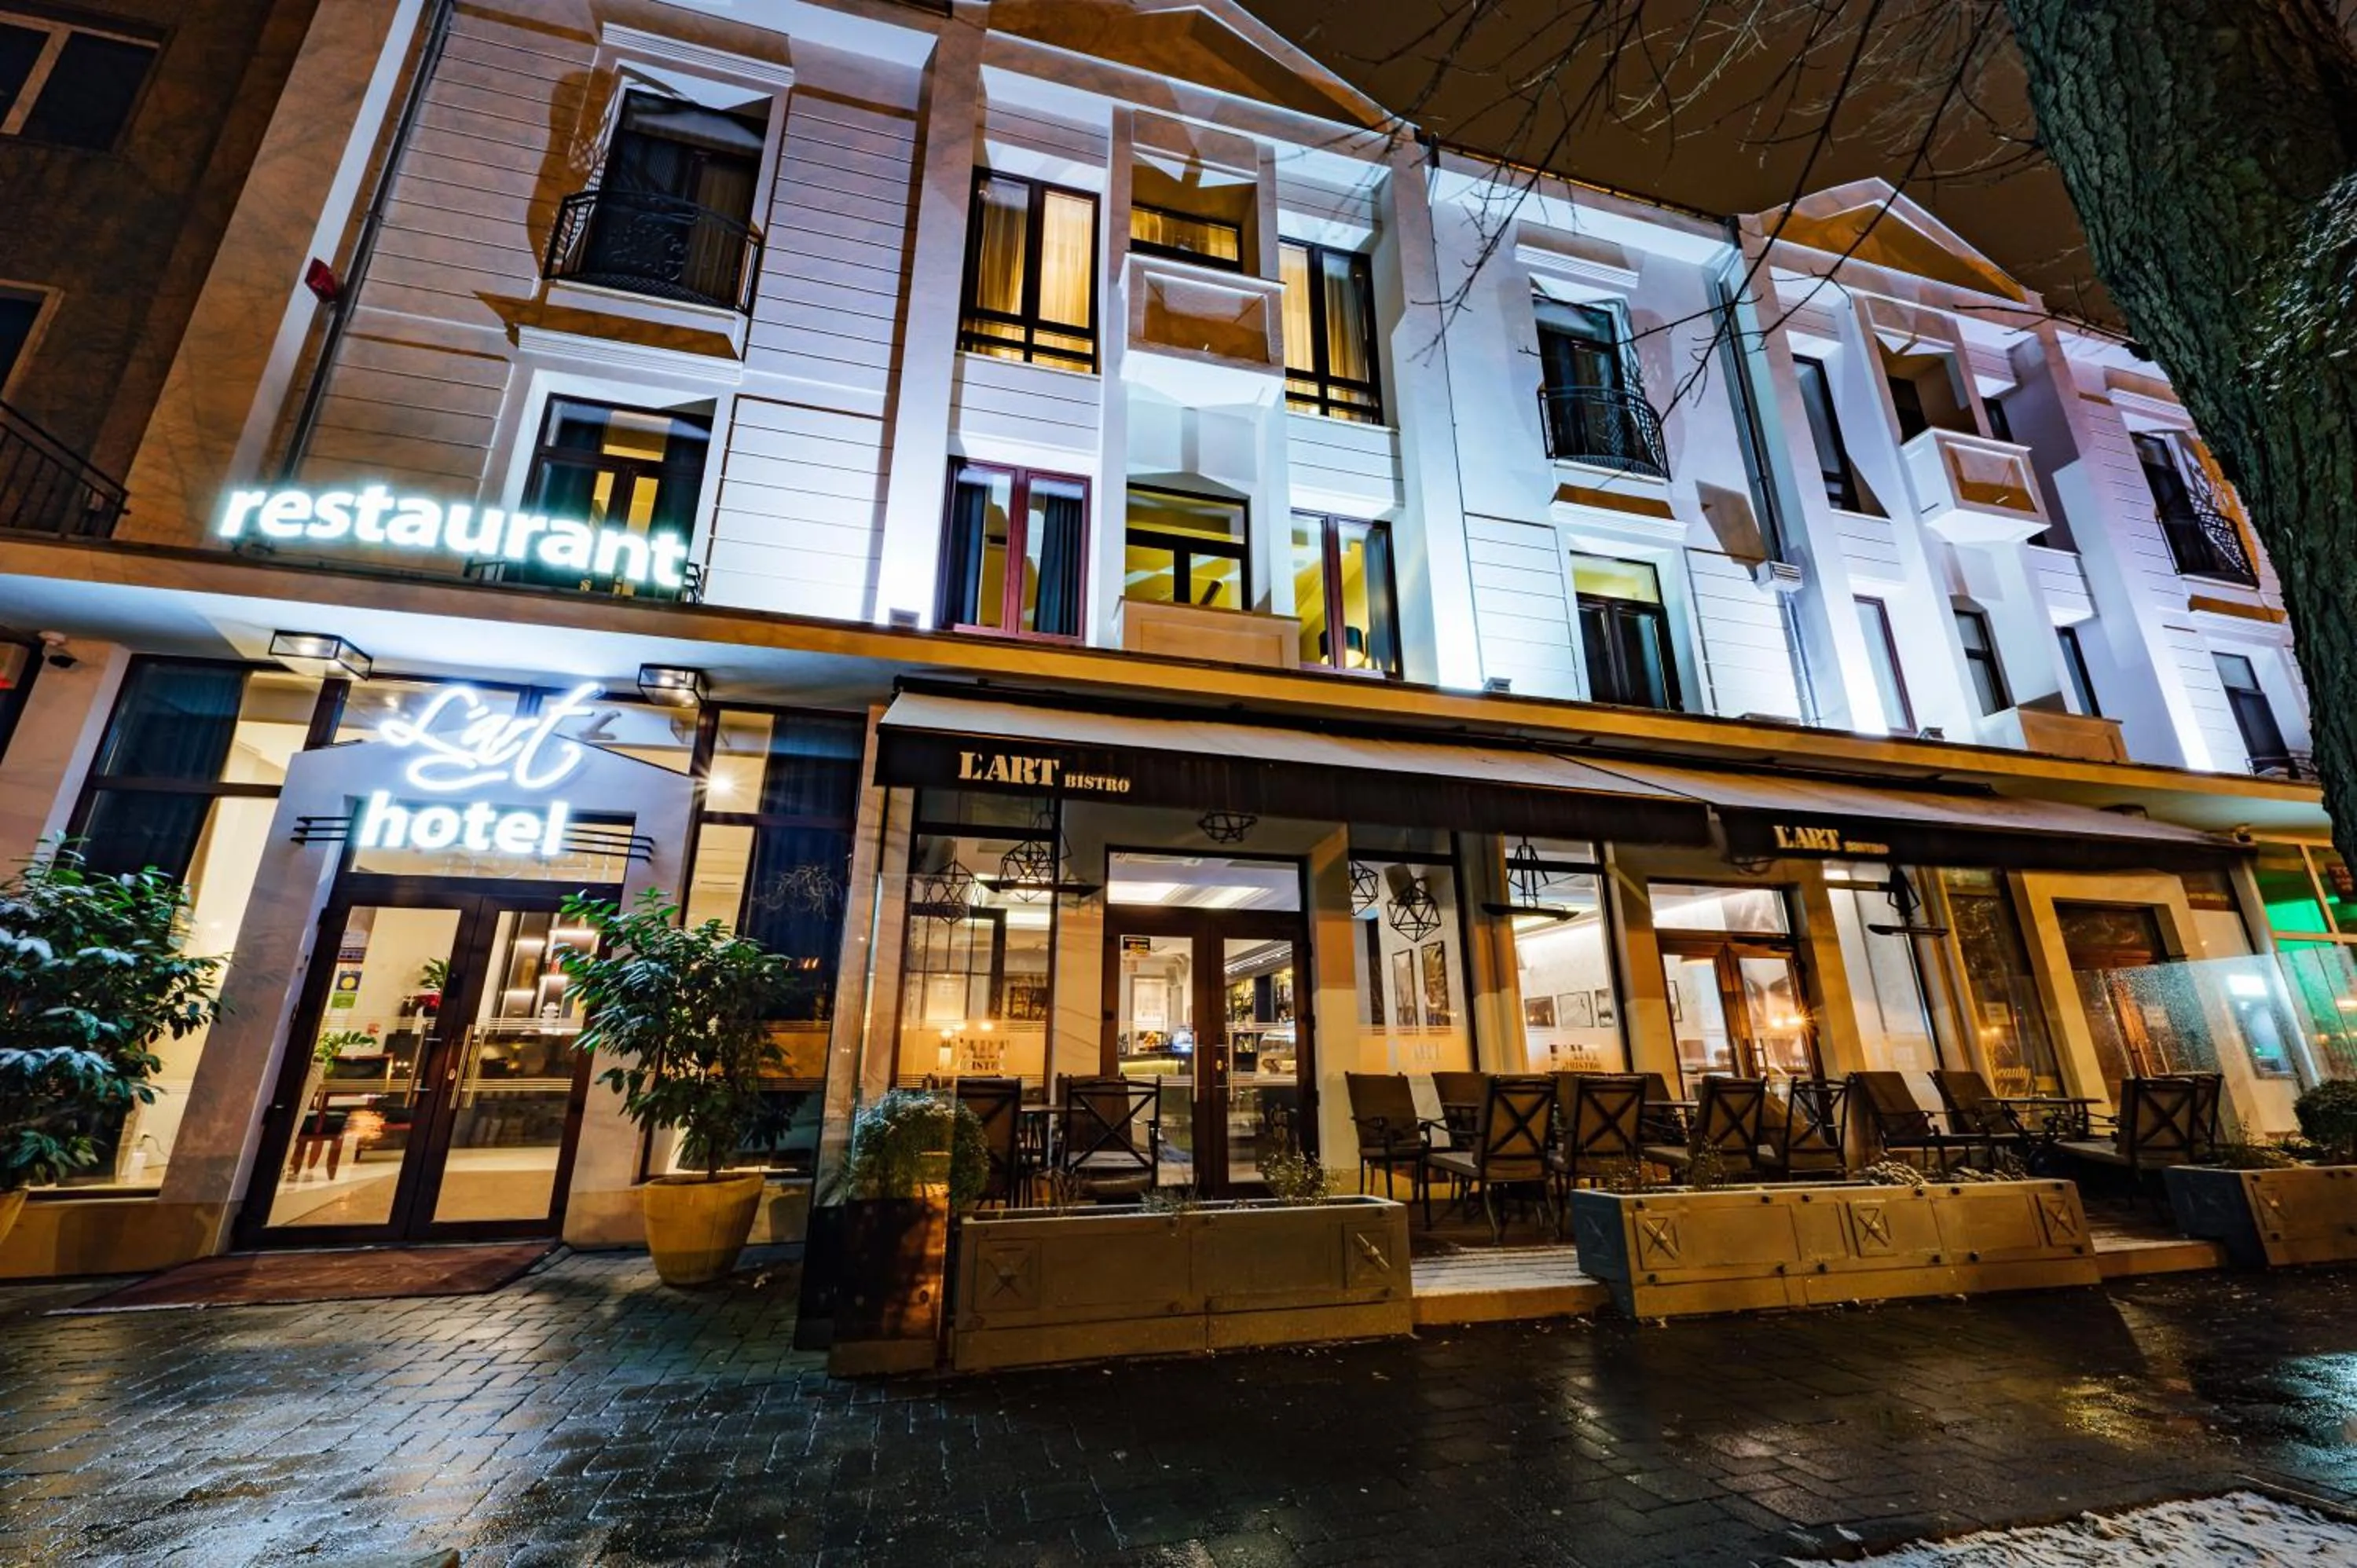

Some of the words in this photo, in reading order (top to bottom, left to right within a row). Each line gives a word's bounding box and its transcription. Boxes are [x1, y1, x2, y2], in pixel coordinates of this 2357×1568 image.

[219, 484, 689, 588] restaurant
[958, 751, 1060, 786] L'ART
[1064, 773, 1131, 793] BISTRO
[358, 789, 570, 857] hotel
[1772, 824, 1841, 852] L'ART
